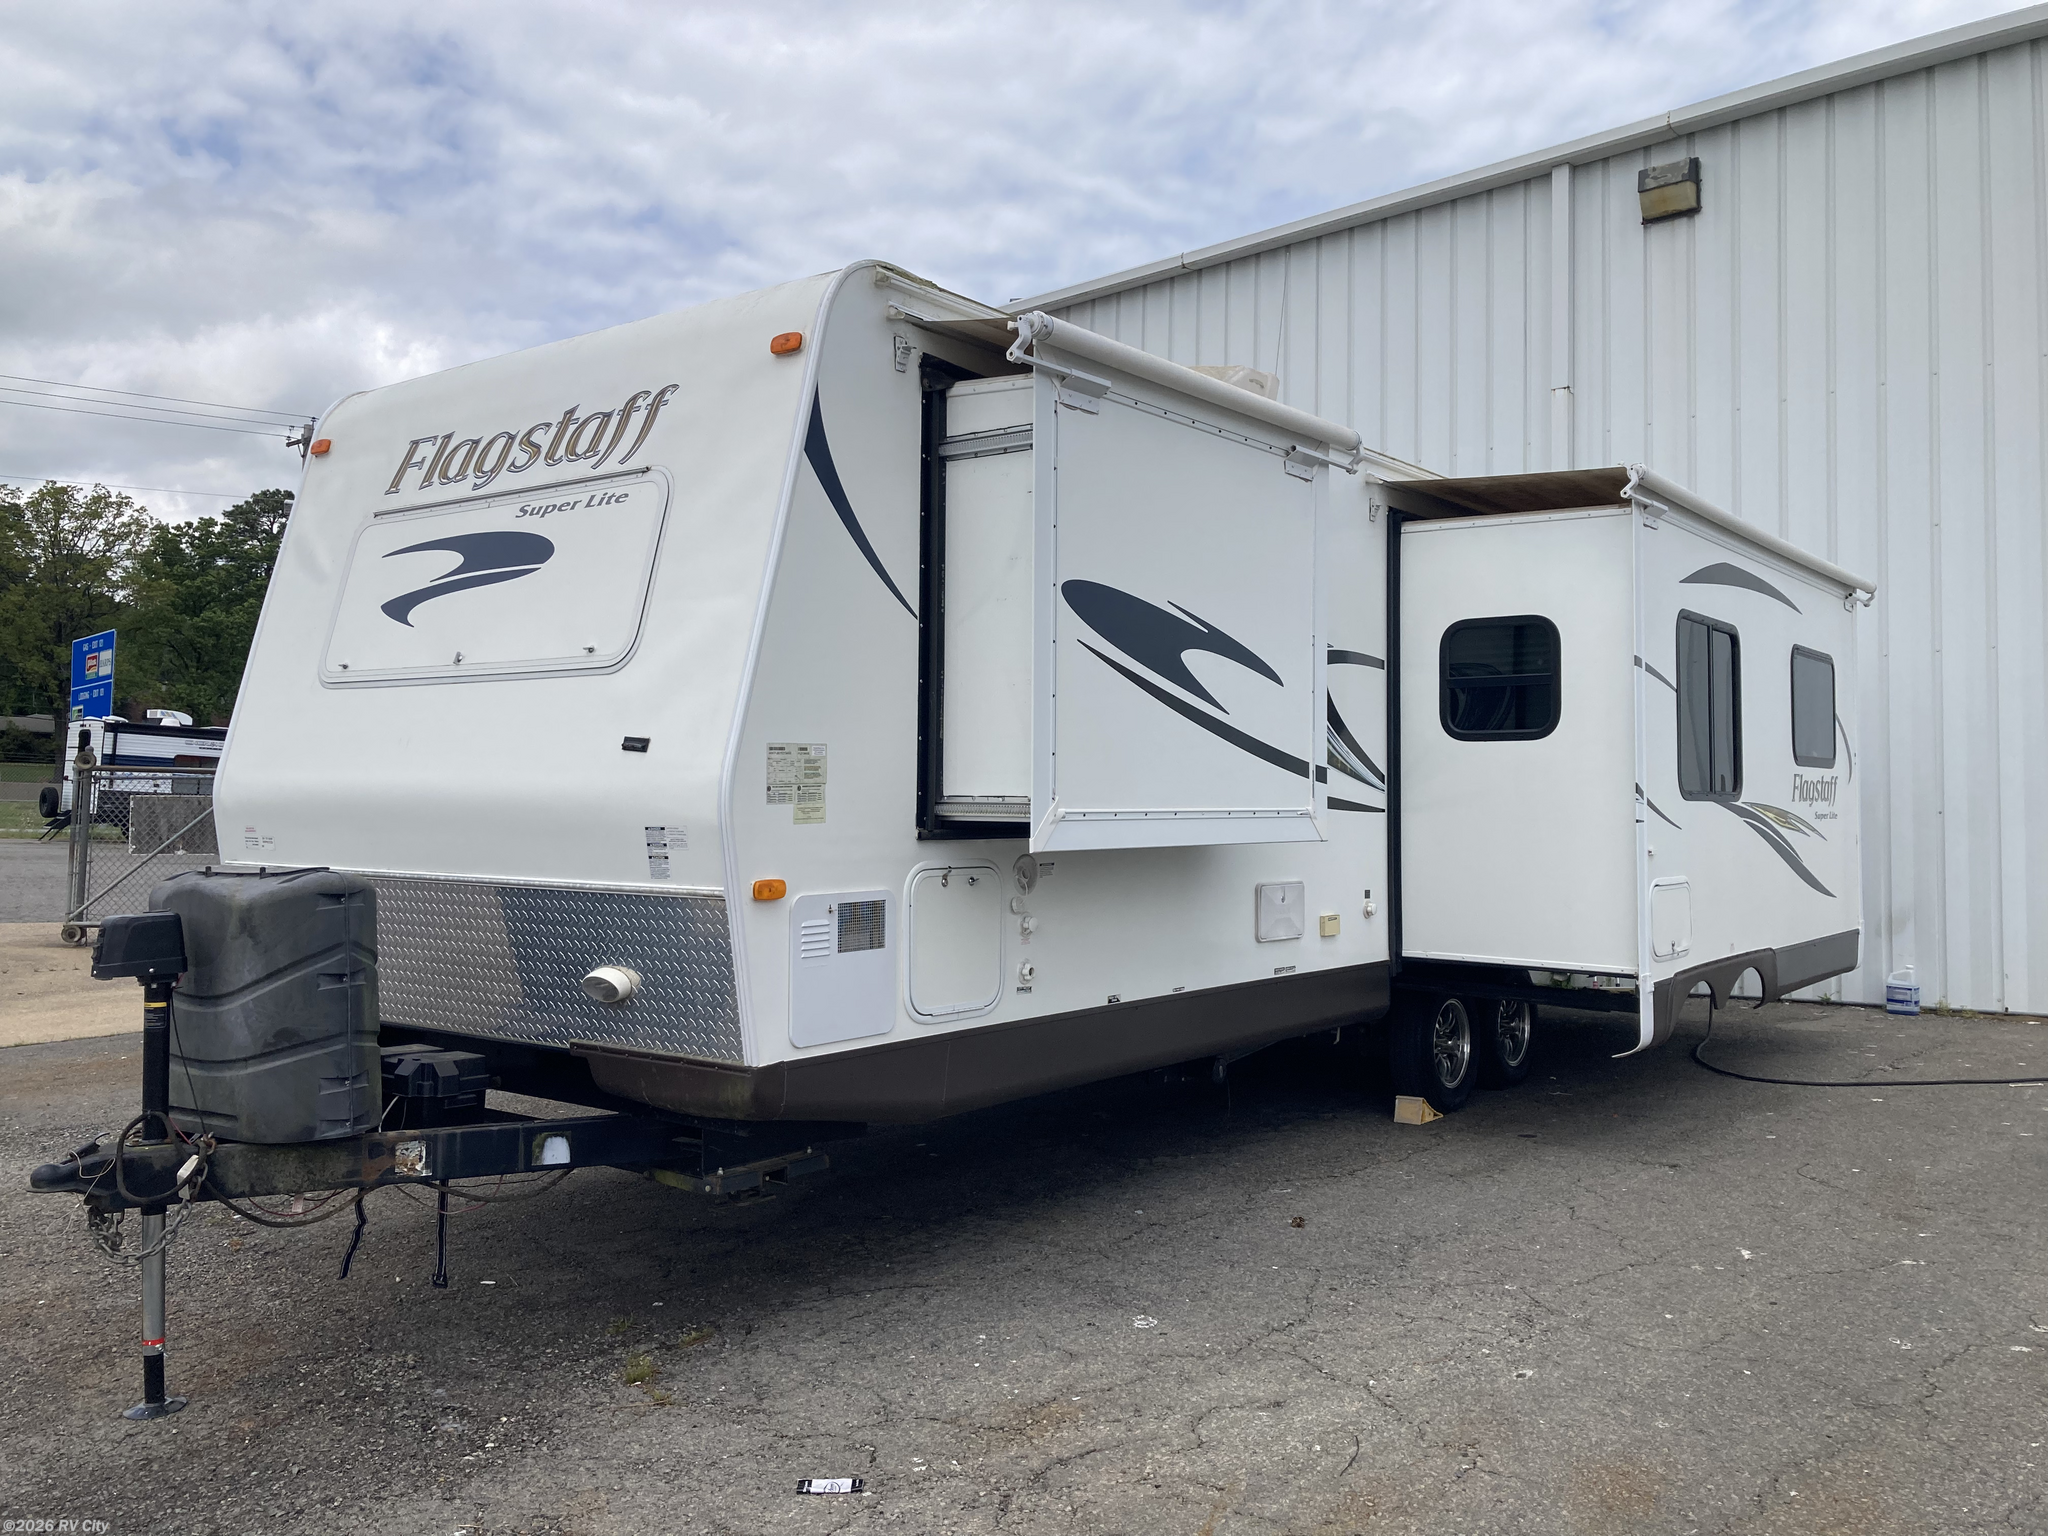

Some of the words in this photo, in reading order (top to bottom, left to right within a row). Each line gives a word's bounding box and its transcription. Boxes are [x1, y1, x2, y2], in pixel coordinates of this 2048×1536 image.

[384, 383, 680, 496] Flagstaff
[515, 500, 583, 518] Super
[584, 492, 629, 508] Lite
[1791, 773, 1838, 807] Flagstaff
[1814, 811, 1829, 822] Super
[1829, 811, 1838, 820] Lite
